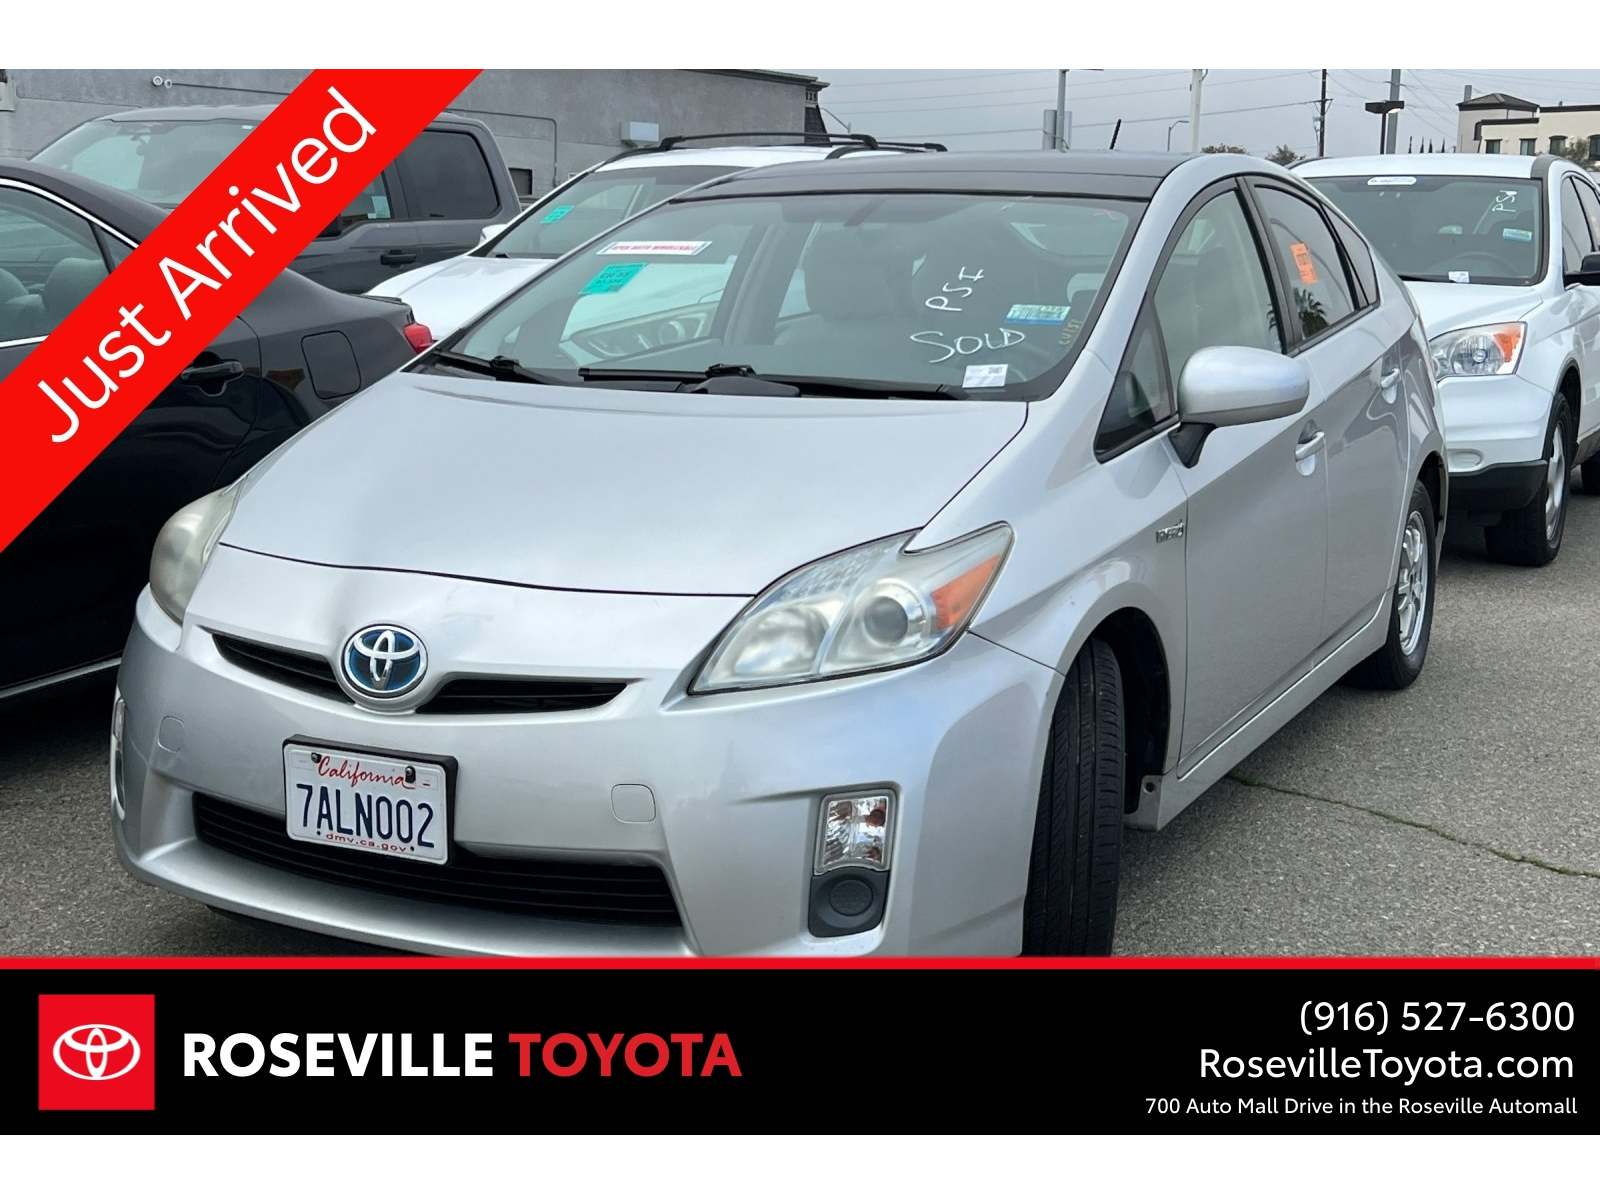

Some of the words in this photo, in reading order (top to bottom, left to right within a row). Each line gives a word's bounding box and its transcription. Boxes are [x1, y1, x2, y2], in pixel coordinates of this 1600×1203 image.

[925, 266, 985, 312] PSI
[910, 327, 1026, 363] SOLD
[318, 755, 416, 790] California
[296, 783, 435, 848] 7ALN002
[325, 833, 407, 852] dmv.ca.gov
